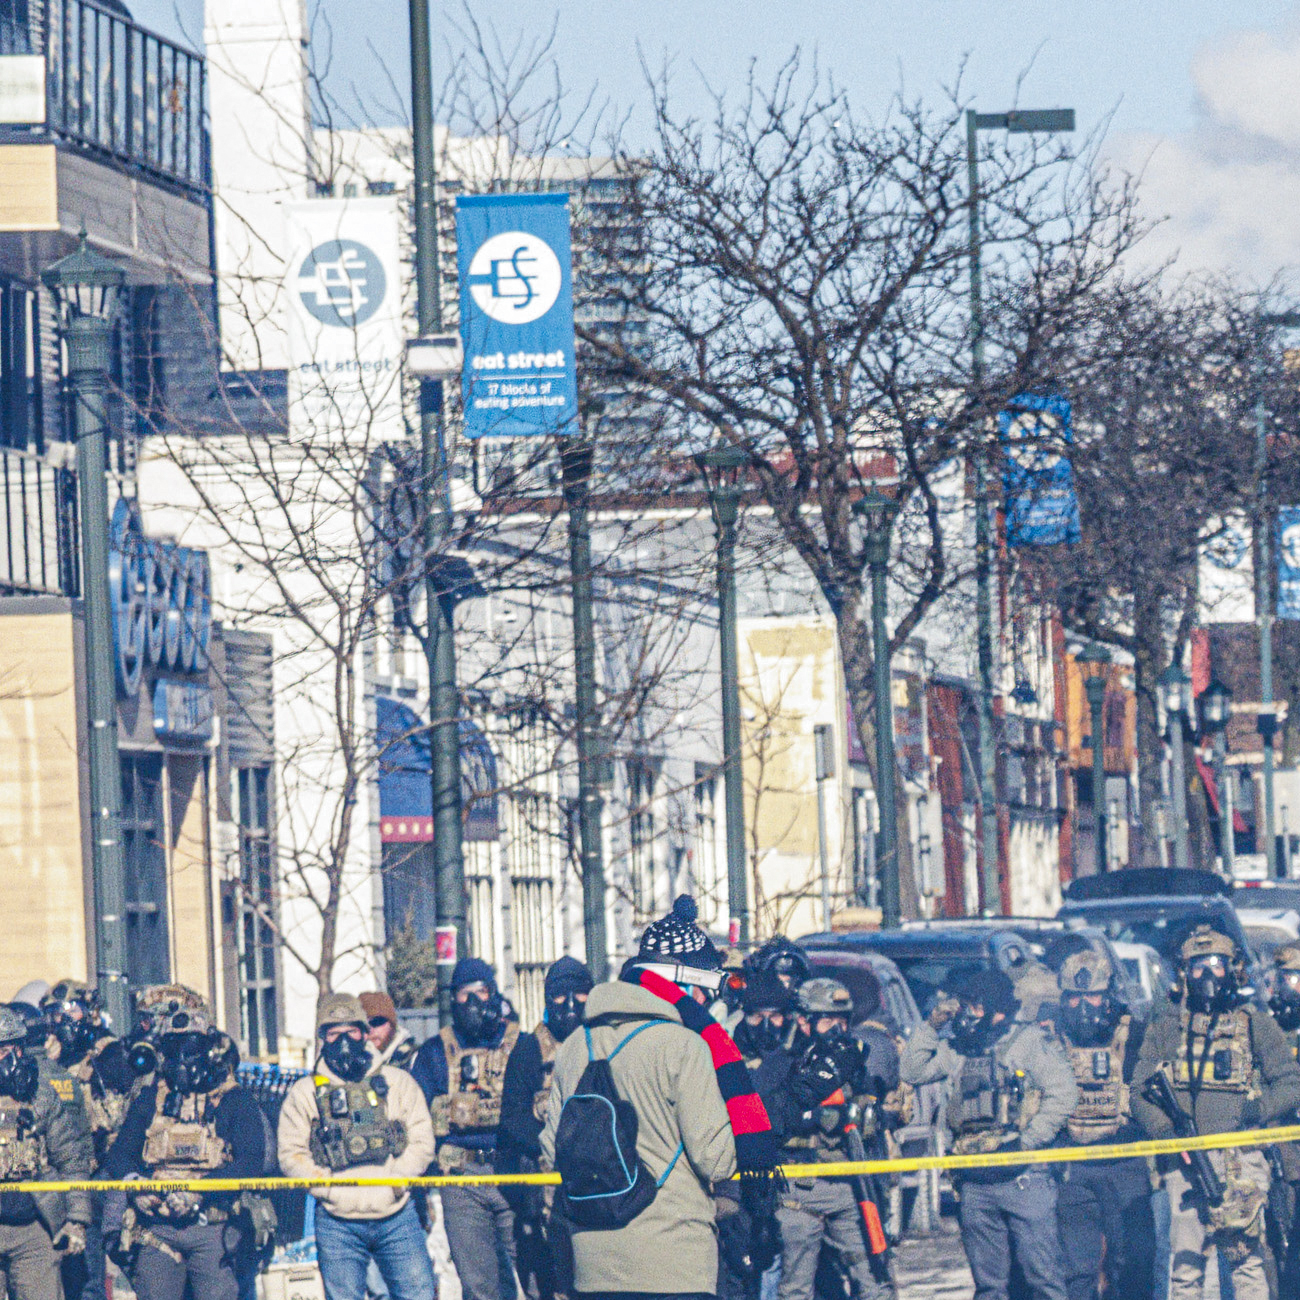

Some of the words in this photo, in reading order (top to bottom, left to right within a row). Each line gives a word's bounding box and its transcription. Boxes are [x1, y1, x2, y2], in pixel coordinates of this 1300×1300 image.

[472, 352, 505, 370] eat
[508, 350, 566, 369] street
[501, 383, 537, 395] blocks
[475, 397, 510, 410] eating
[511, 396, 566, 408] adventure
[1079, 1095, 1115, 1106] OLICE
